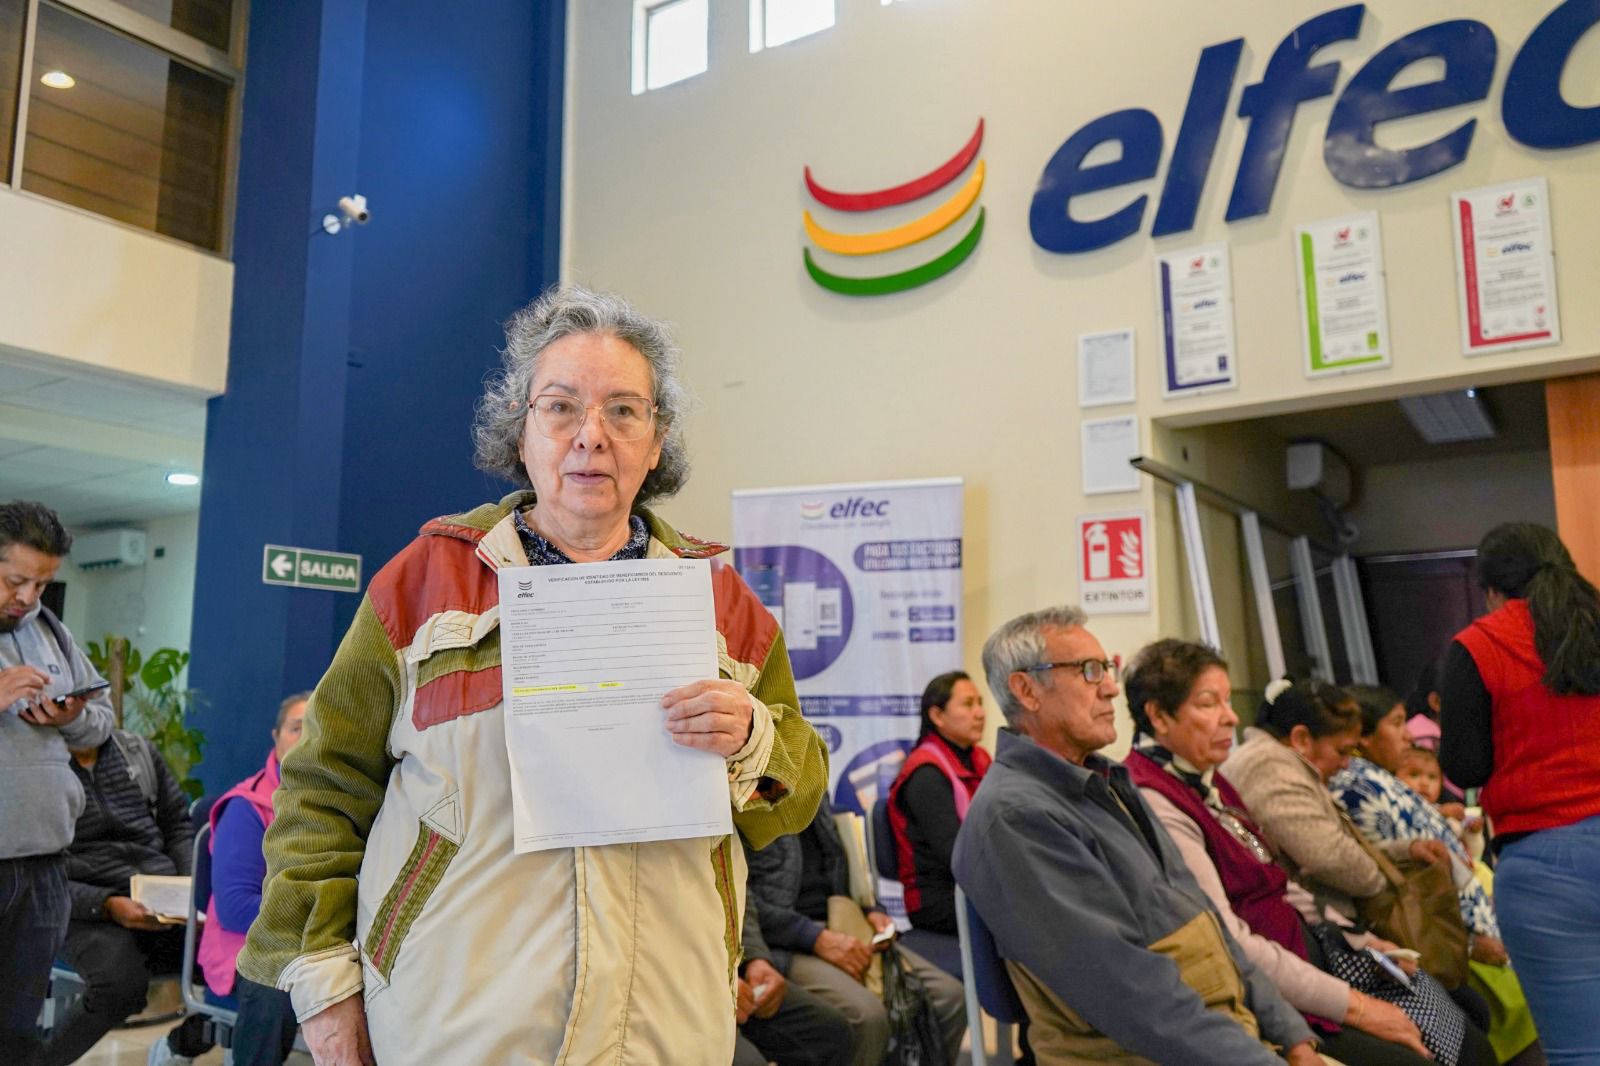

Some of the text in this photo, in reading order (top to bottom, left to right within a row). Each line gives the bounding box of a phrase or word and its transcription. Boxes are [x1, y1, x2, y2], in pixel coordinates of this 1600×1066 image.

[1029, 0, 1600, 254] elfec
[830, 496, 891, 519] elfec
[300, 560, 356, 581] SALIDA
[1084, 590, 1145, 602] EXTINTOR
